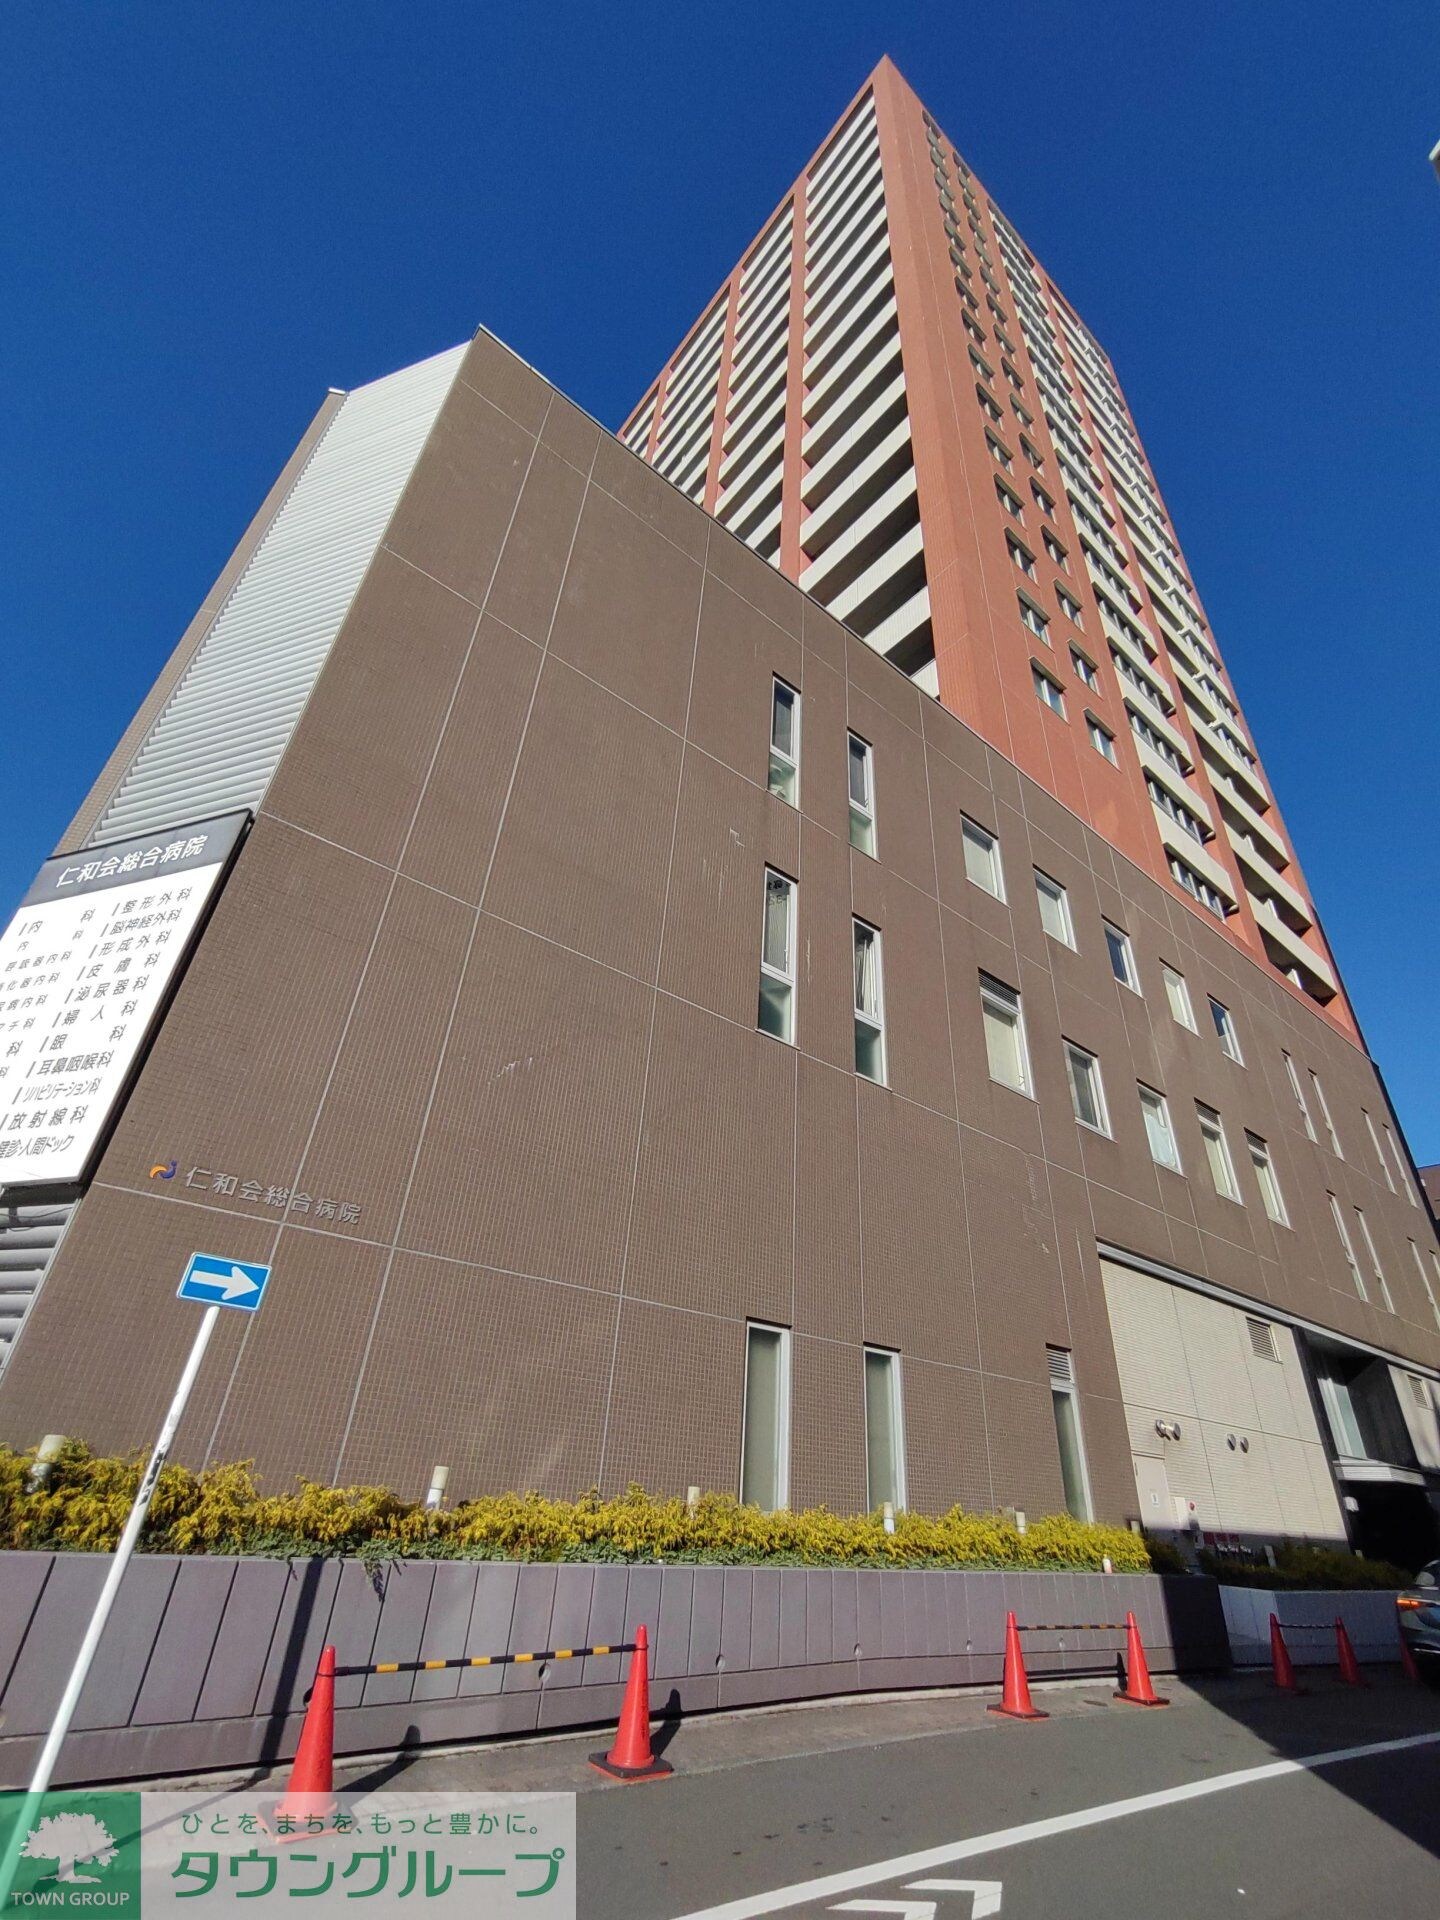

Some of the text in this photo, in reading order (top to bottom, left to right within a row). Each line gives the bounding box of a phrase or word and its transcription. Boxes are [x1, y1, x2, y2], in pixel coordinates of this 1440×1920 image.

[55, 834, 208, 888] 仁和会総合病院
[121, 886, 193, 914] 整形外科
[110, 907, 182, 935] 脳神経外科
[99, 929, 171, 956] 形成外科
[74, 974, 149, 1002] 泌尿器科
[62, 999, 138, 1026] 婦人科
[36, 1049, 115, 1075] 耳鼻咽喉科
[22, 1077, 103, 1103] リハビリテーション科
[7, 1104, 89, 1130] 放射線科
[185, 1166, 362, 1224] 仁和会総合病院
